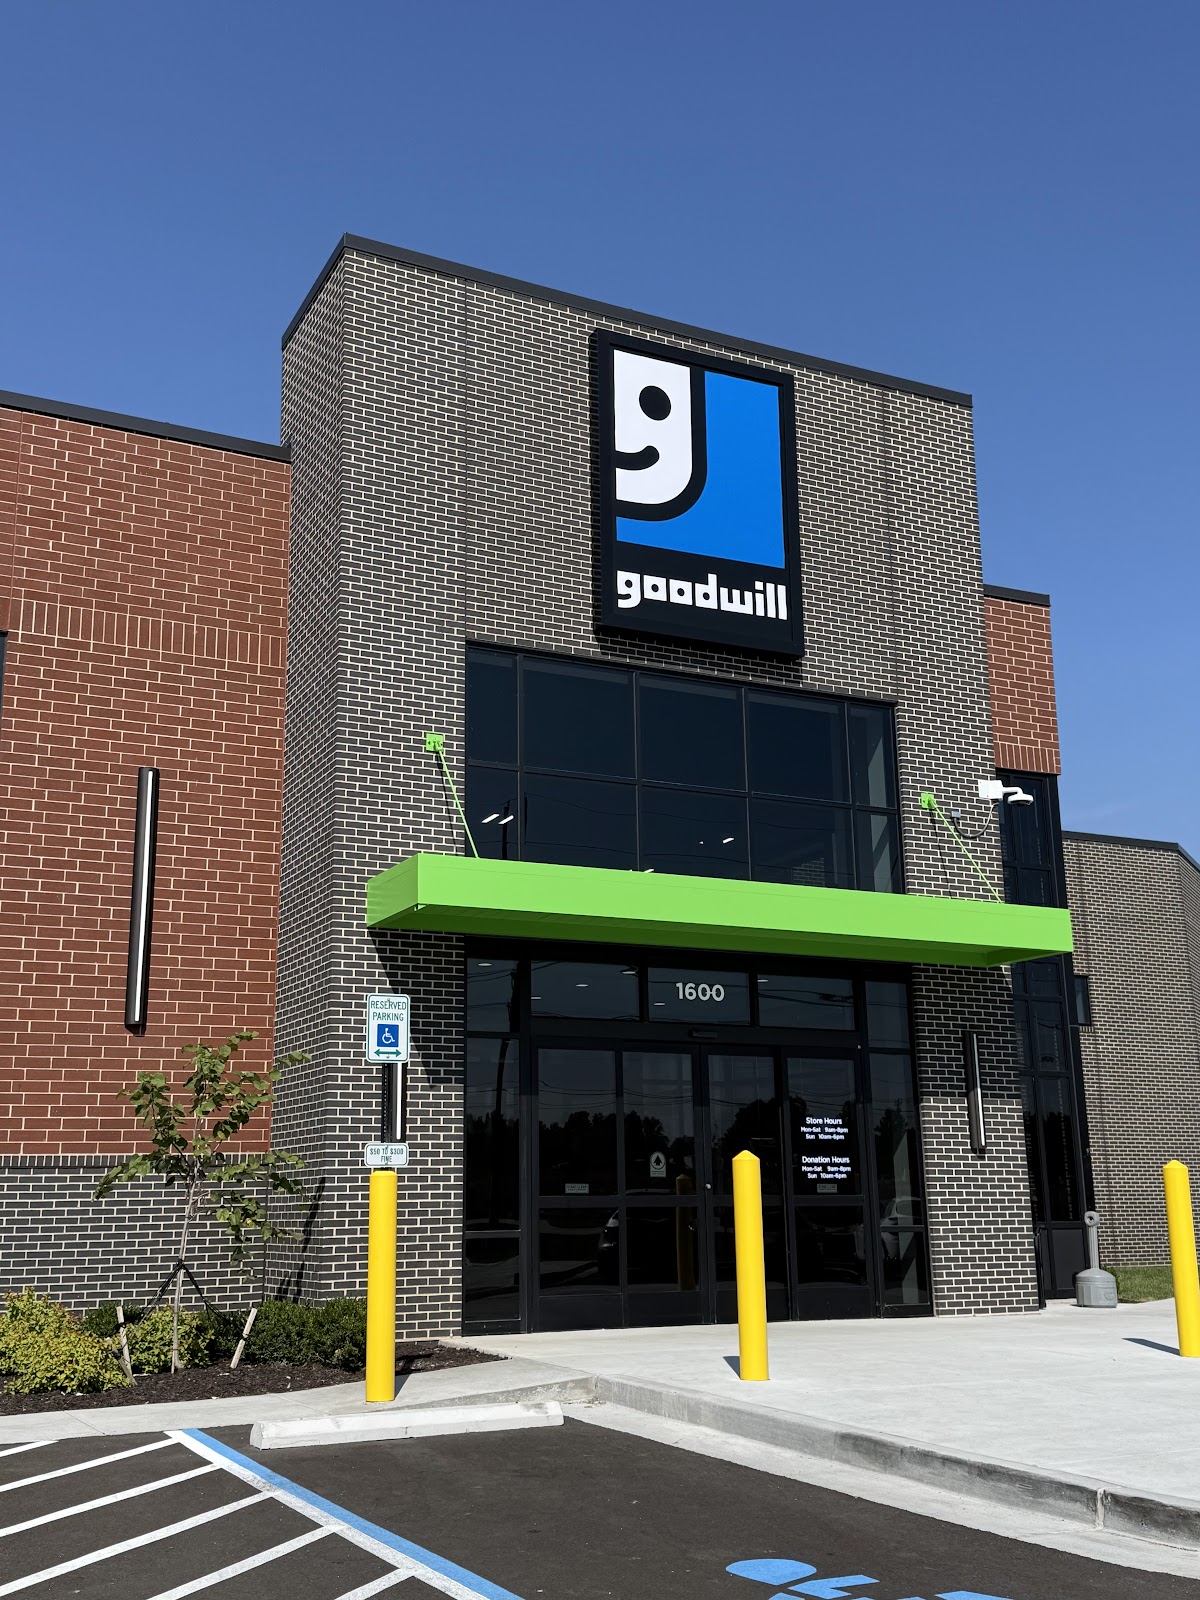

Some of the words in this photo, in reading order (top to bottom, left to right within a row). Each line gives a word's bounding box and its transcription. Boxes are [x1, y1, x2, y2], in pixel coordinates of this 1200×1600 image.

[616, 570, 788, 620] goodwill
[675, 982, 725, 1002] 1600
[371, 1000, 406, 1010] RESERVED
[373, 1012, 404, 1021] PARKING
